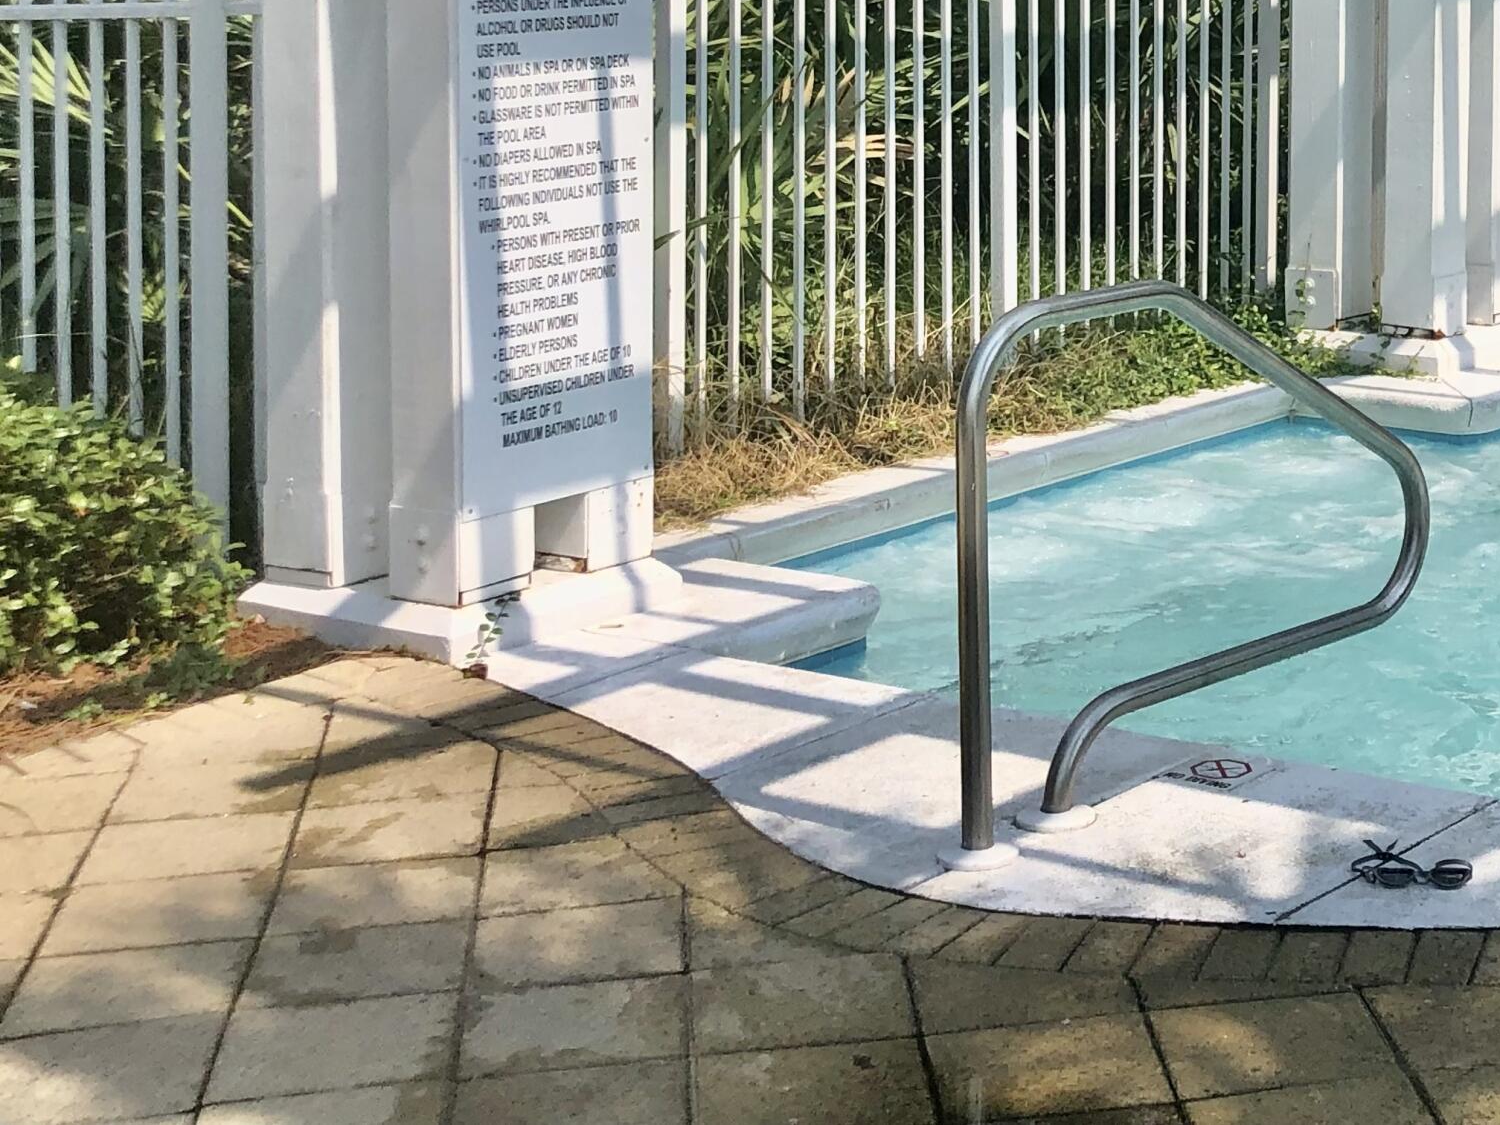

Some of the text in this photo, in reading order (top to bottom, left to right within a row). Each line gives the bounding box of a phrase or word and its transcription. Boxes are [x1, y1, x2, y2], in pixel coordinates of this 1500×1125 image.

[476, 13, 619, 36] ALCOHOL OR DRUGS SHOULD NOT
[477, 42, 521, 58] USE POOL
[478, 54, 629, 80] NO ANIMALS IN SPA OR ON SPA DECK
[478, 75, 635, 102] NO FOOD OR DRINK PERMITTED IN SPA
[479, 95, 639, 124] GLASSWARE IS NOT PERMITTED WITHIN
[478, 126, 546, 146] THE POOL AREA
[479, 140, 602, 167] NO DIAPERS ALLOWED IN SPA
[478, 157, 636, 190] IT IS HIGHLY RECOMMENDED THAT THE
[478, 178, 638, 212] FOLLOWING INDIVIDUALS NOT USE THE
[479, 214, 530, 234] WHIRLPOOL
[497, 219, 640, 253] PERSONS WITH PRESENT OR PRIOR
[497, 258, 525, 275] HEART
[568, 248, 587, 263] HIGH
[590, 243, 617, 260] BLOOD
[548, 275, 560, 288] OR
[561, 271, 578, 285] ANY
[580, 265, 616, 282] CHRONIC
[498, 292, 578, 319] HEALTH PROBLEMS
[499, 313, 578, 340] PREGNANT WOMEN
[499, 335, 578, 362] ELDERLY PERSONS
[500, 345, 631, 384] CHILDREN UNDER THE AGE OF 10
[499, 364, 634, 405] UNSUPERVISED CHILDREN UNDER
[501, 401, 562, 426] THE AGE OF 12
[502, 426, 543, 448] MAXIMUM
[545, 419, 581, 438] BATHING
[609, 409, 617, 423] 10
